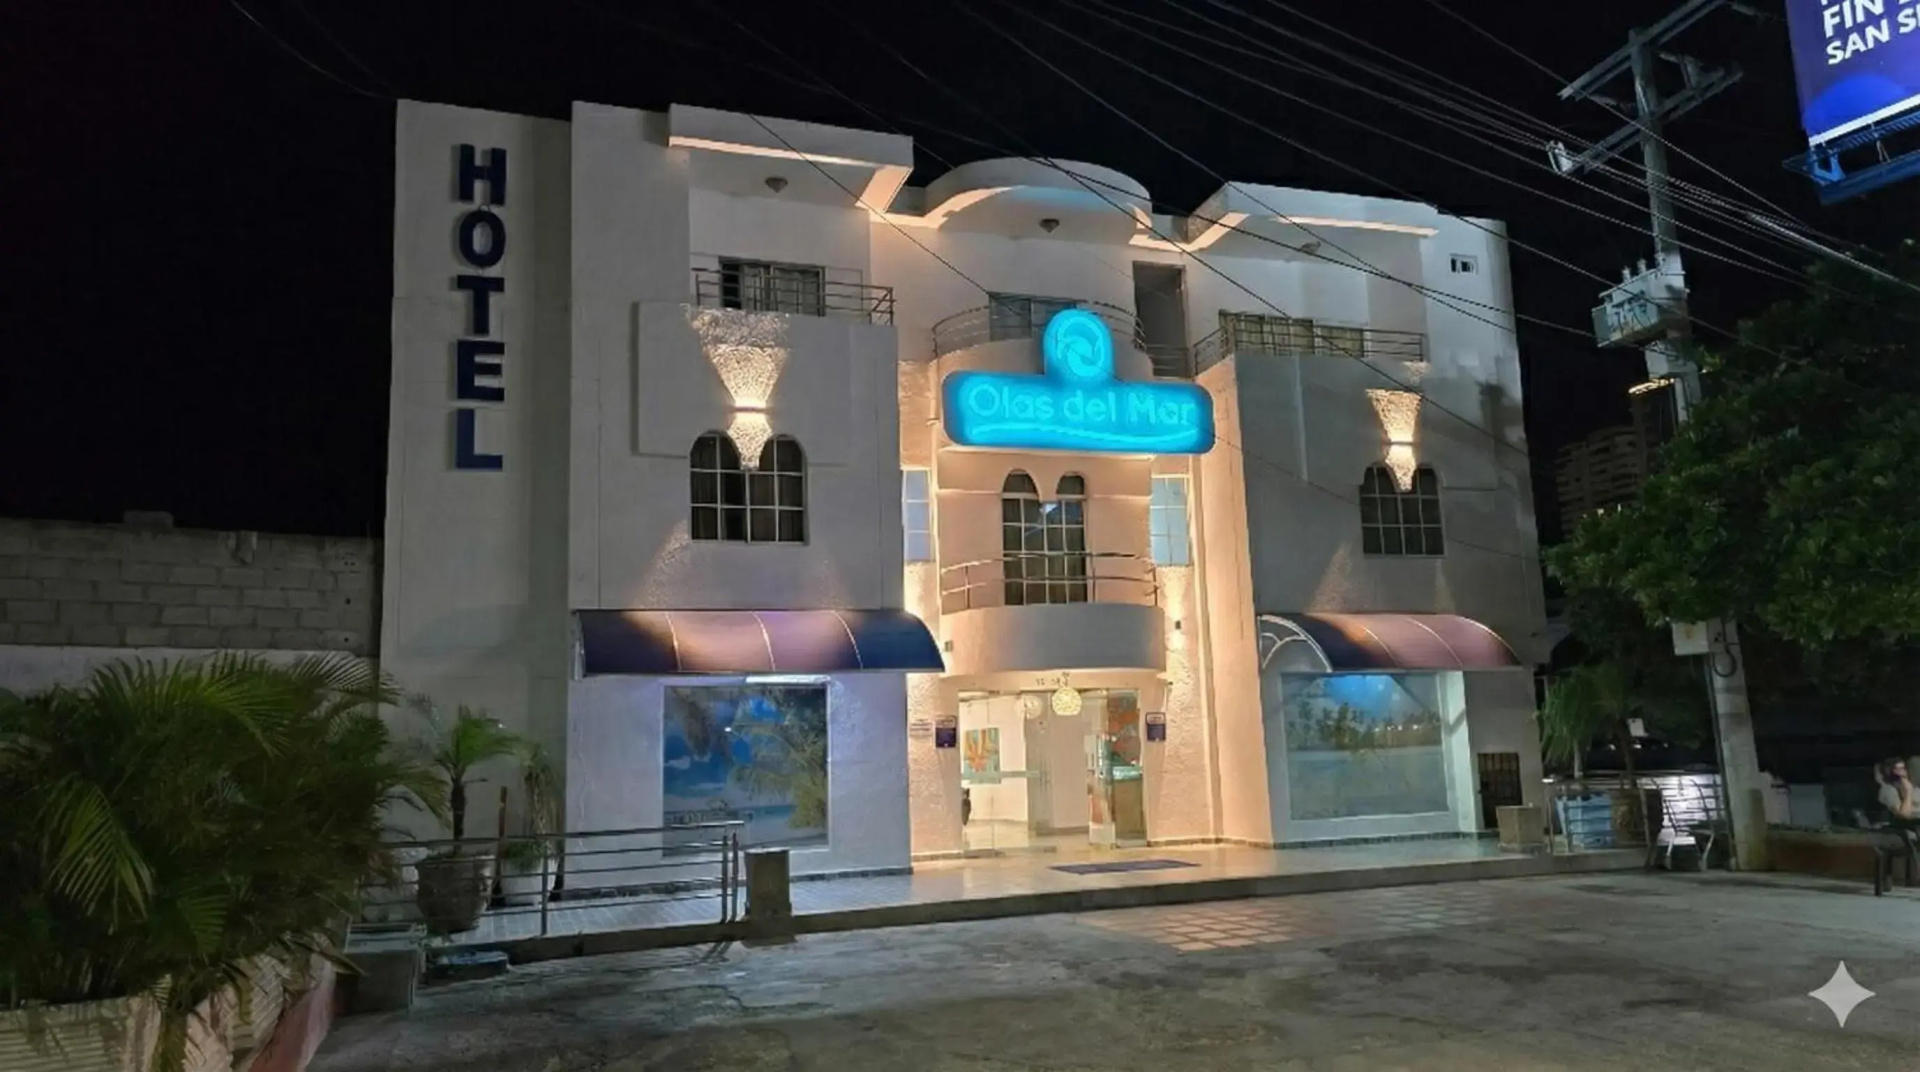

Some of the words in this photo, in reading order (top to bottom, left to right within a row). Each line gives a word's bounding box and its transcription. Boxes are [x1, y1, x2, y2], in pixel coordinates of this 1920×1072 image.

[1823, 0, 1884, 38] FIN
[1826, 18, 1890, 65] SAN
[1897, 3, 1920, 34] S
[456, 143, 507, 470] HOTEL
[969, 384, 1054, 419] Olas
[1063, 390, 1116, 422] del
[1128, 393, 1197, 424] Mar
